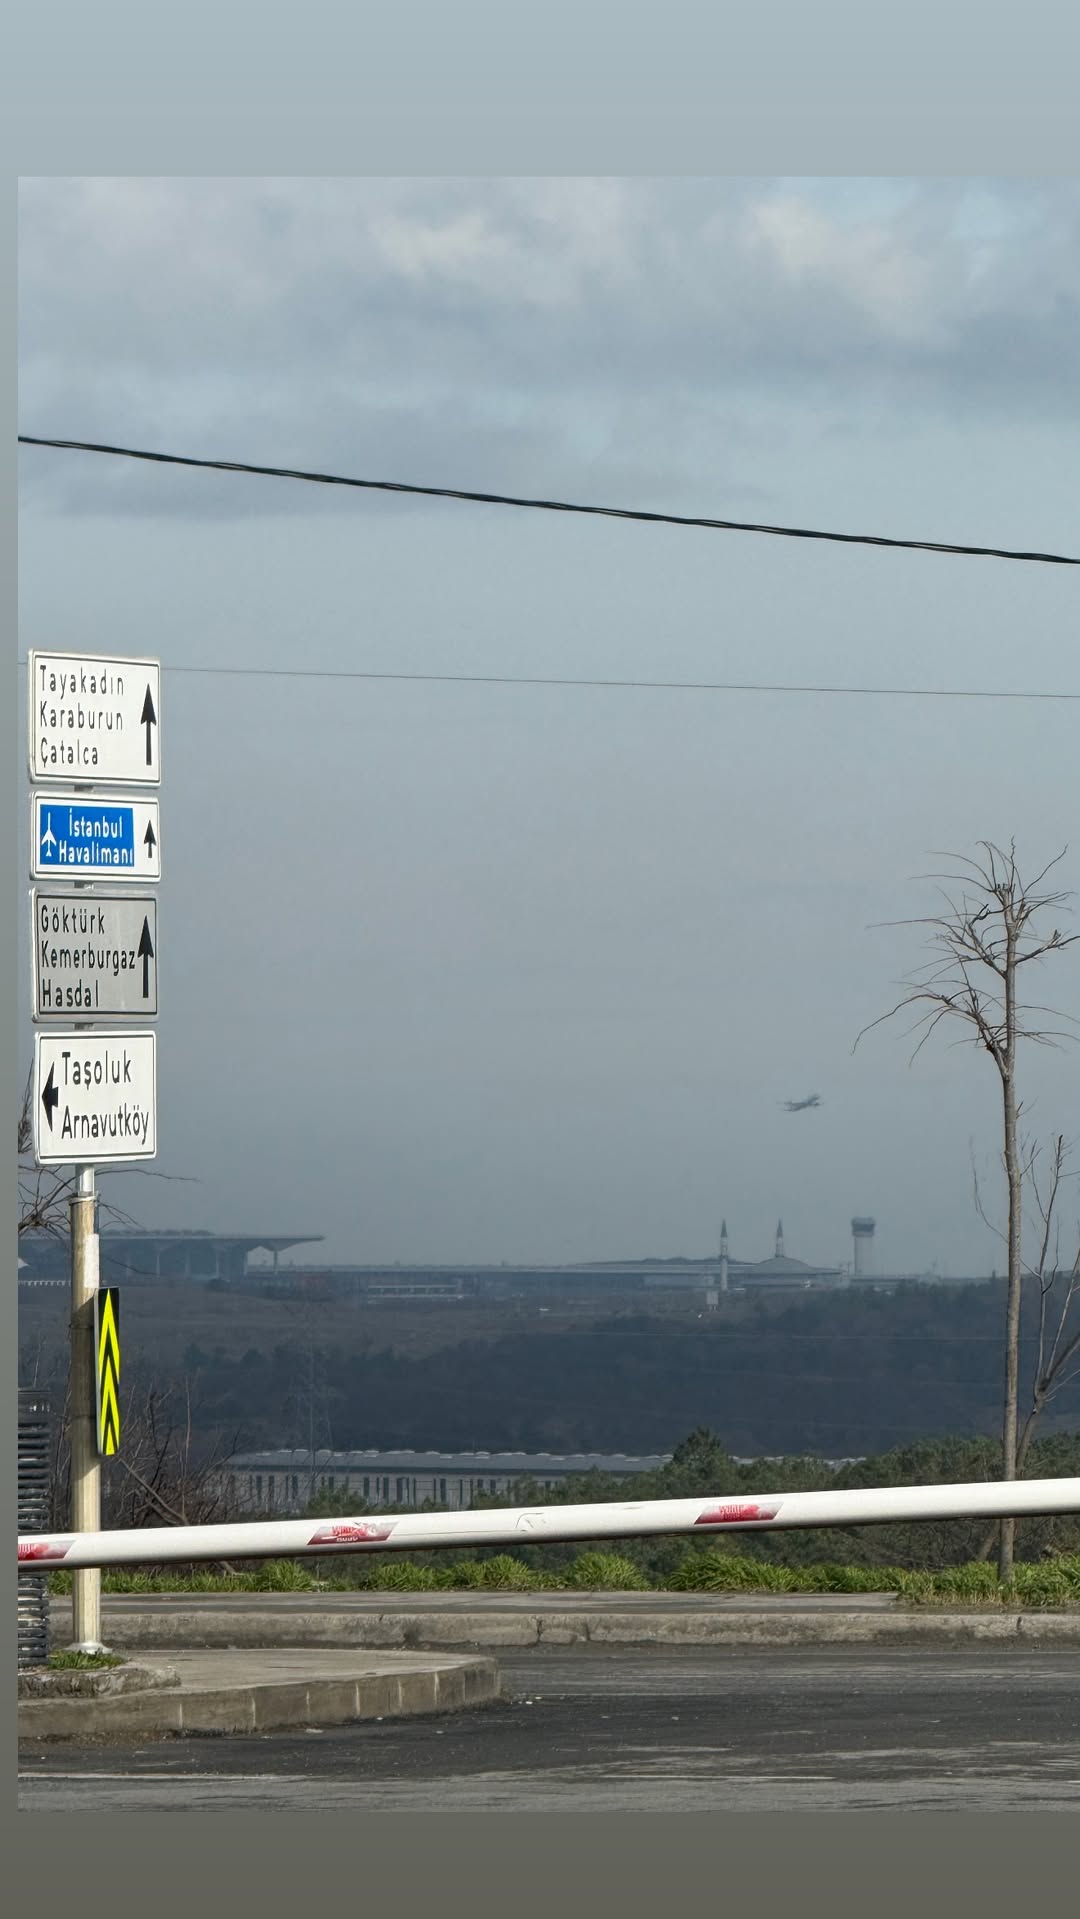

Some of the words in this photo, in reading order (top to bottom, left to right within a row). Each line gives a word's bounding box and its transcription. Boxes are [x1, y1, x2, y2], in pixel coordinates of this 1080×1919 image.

[40, 665, 123, 700] Tayakadın
[40, 700, 123, 730] Karaburun
[40, 737, 98, 768] Çatalca
[69, 807, 123, 838] İstanbul
[59, 840, 133, 864] Havalimanı
[41, 905, 105, 934] Göktürk
[41, 940, 135, 976] Kemerburgaz
[42, 979, 99, 1007] Hasdal
[61, 1049, 131, 1090] Taşoluk
[61, 1102, 149, 1145] Arnavutköy
